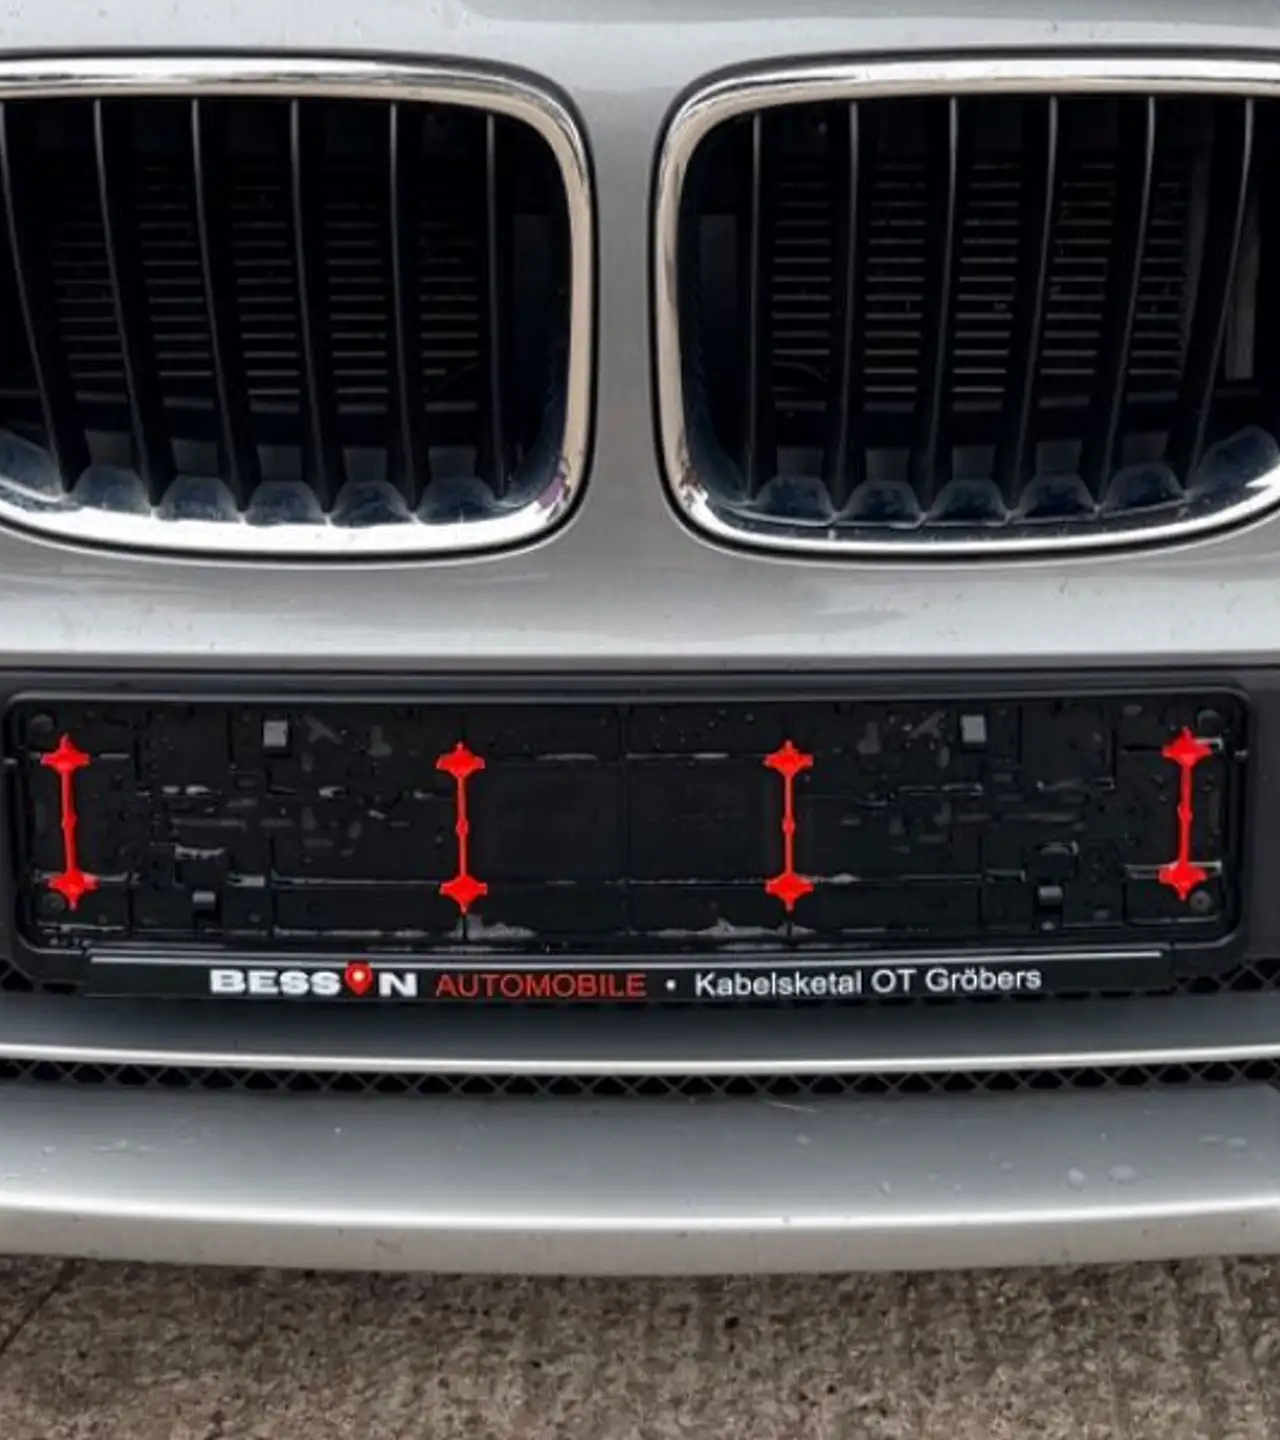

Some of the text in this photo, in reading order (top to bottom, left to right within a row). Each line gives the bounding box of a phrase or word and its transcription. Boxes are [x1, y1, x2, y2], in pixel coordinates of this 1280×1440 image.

[435, 972, 647, 998] AUTOMOBILE
[695, 970, 861, 996] Kabelsketal
[870, 969, 917, 994] OT
[925, 967, 1043, 993] Gröbers
